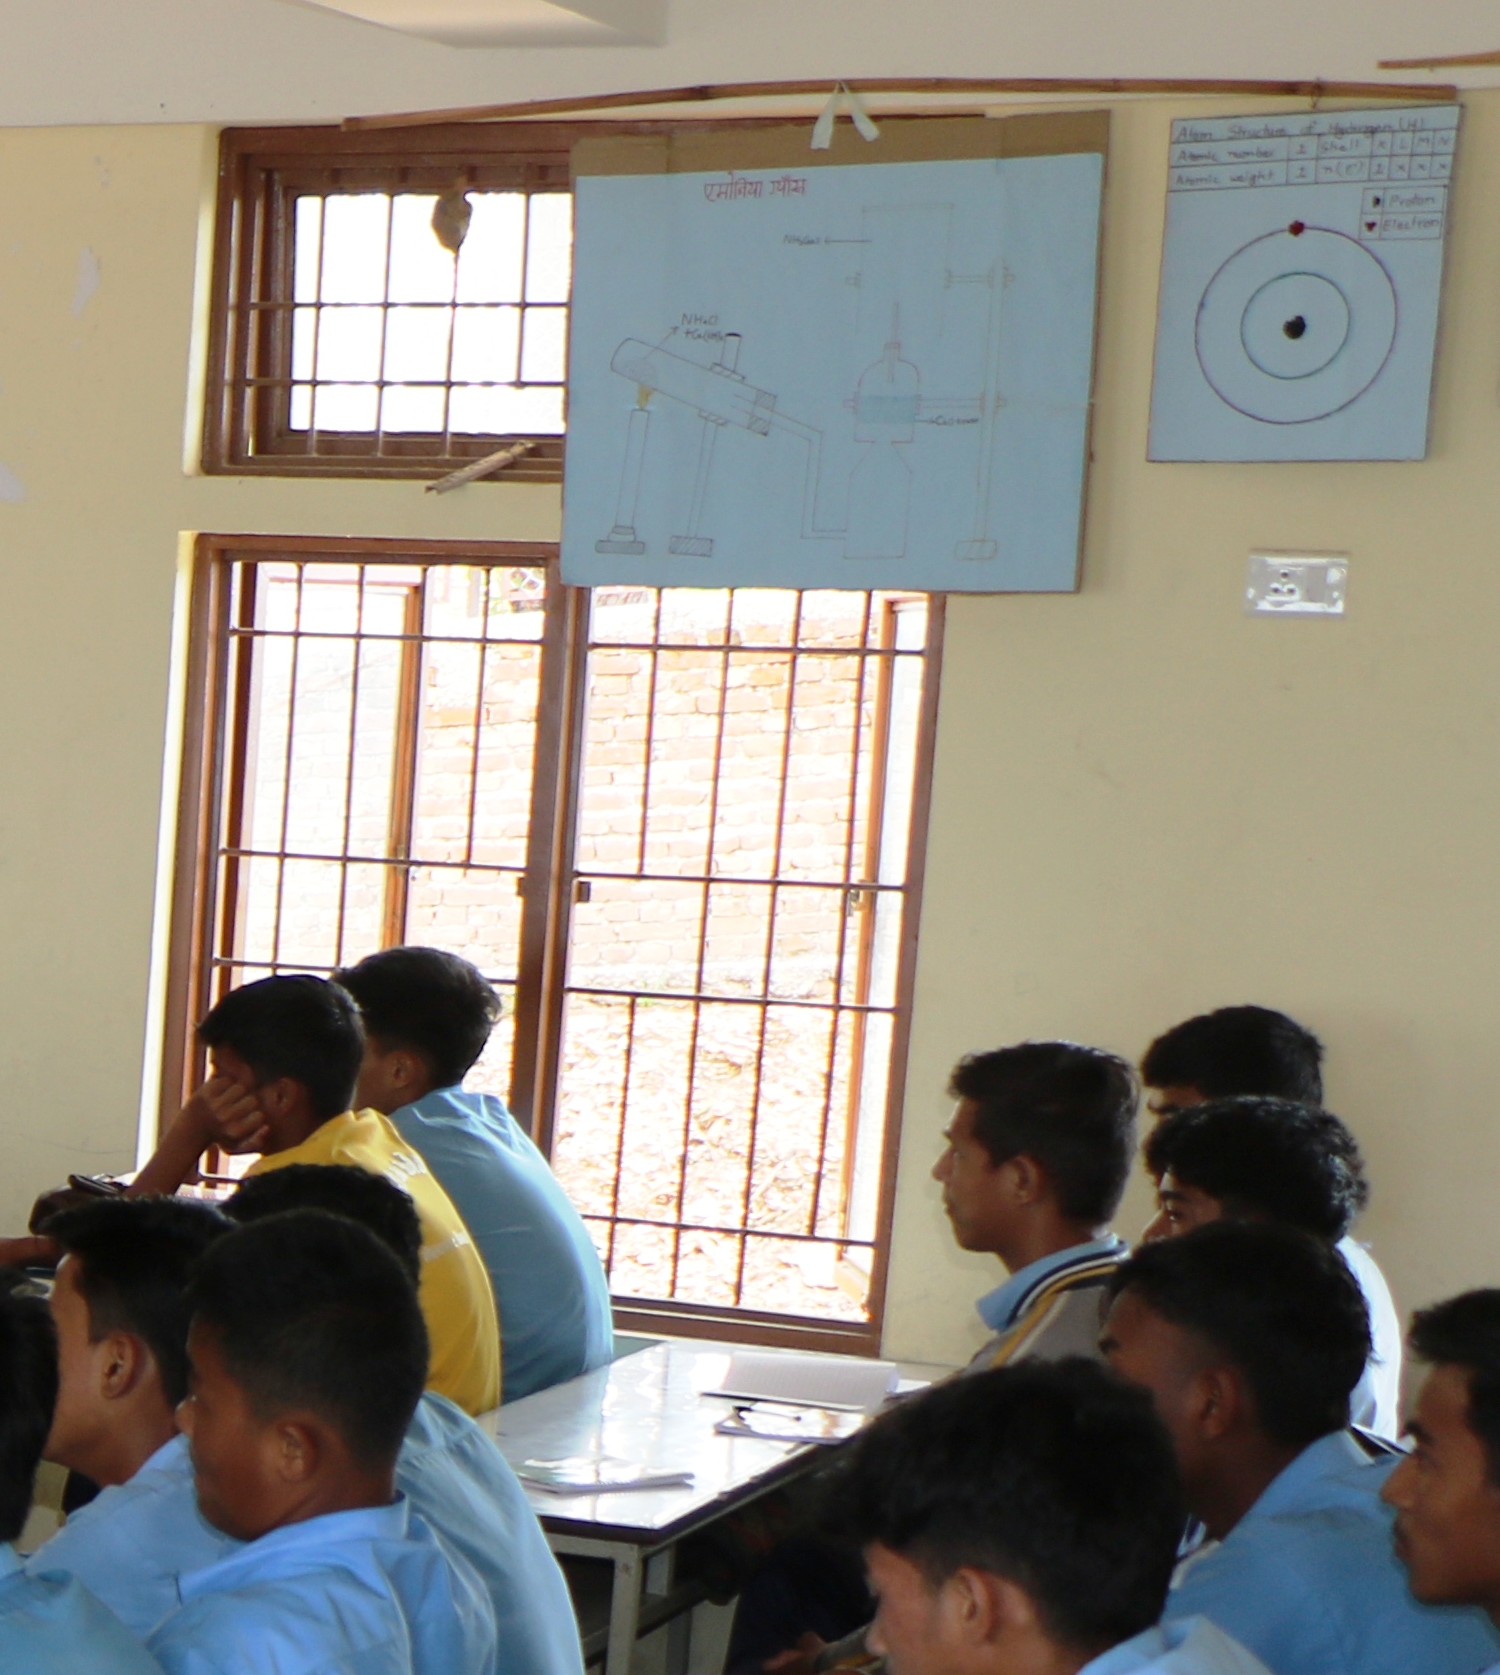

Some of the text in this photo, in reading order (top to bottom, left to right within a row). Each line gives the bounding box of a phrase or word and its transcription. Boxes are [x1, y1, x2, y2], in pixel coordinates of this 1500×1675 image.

[1328, 122, 1394, 139] Hydrogen
[1177, 147, 1217, 161] Atomic
[1227, 147, 1274, 159] number
[1175, 173, 1220, 185] Atomic
[1229, 169, 1274, 187] weight
[703, 170, 763, 203] एमोनिया
[1388, 193, 1436, 206] Proton
[1382, 217, 1440, 232] Electron
